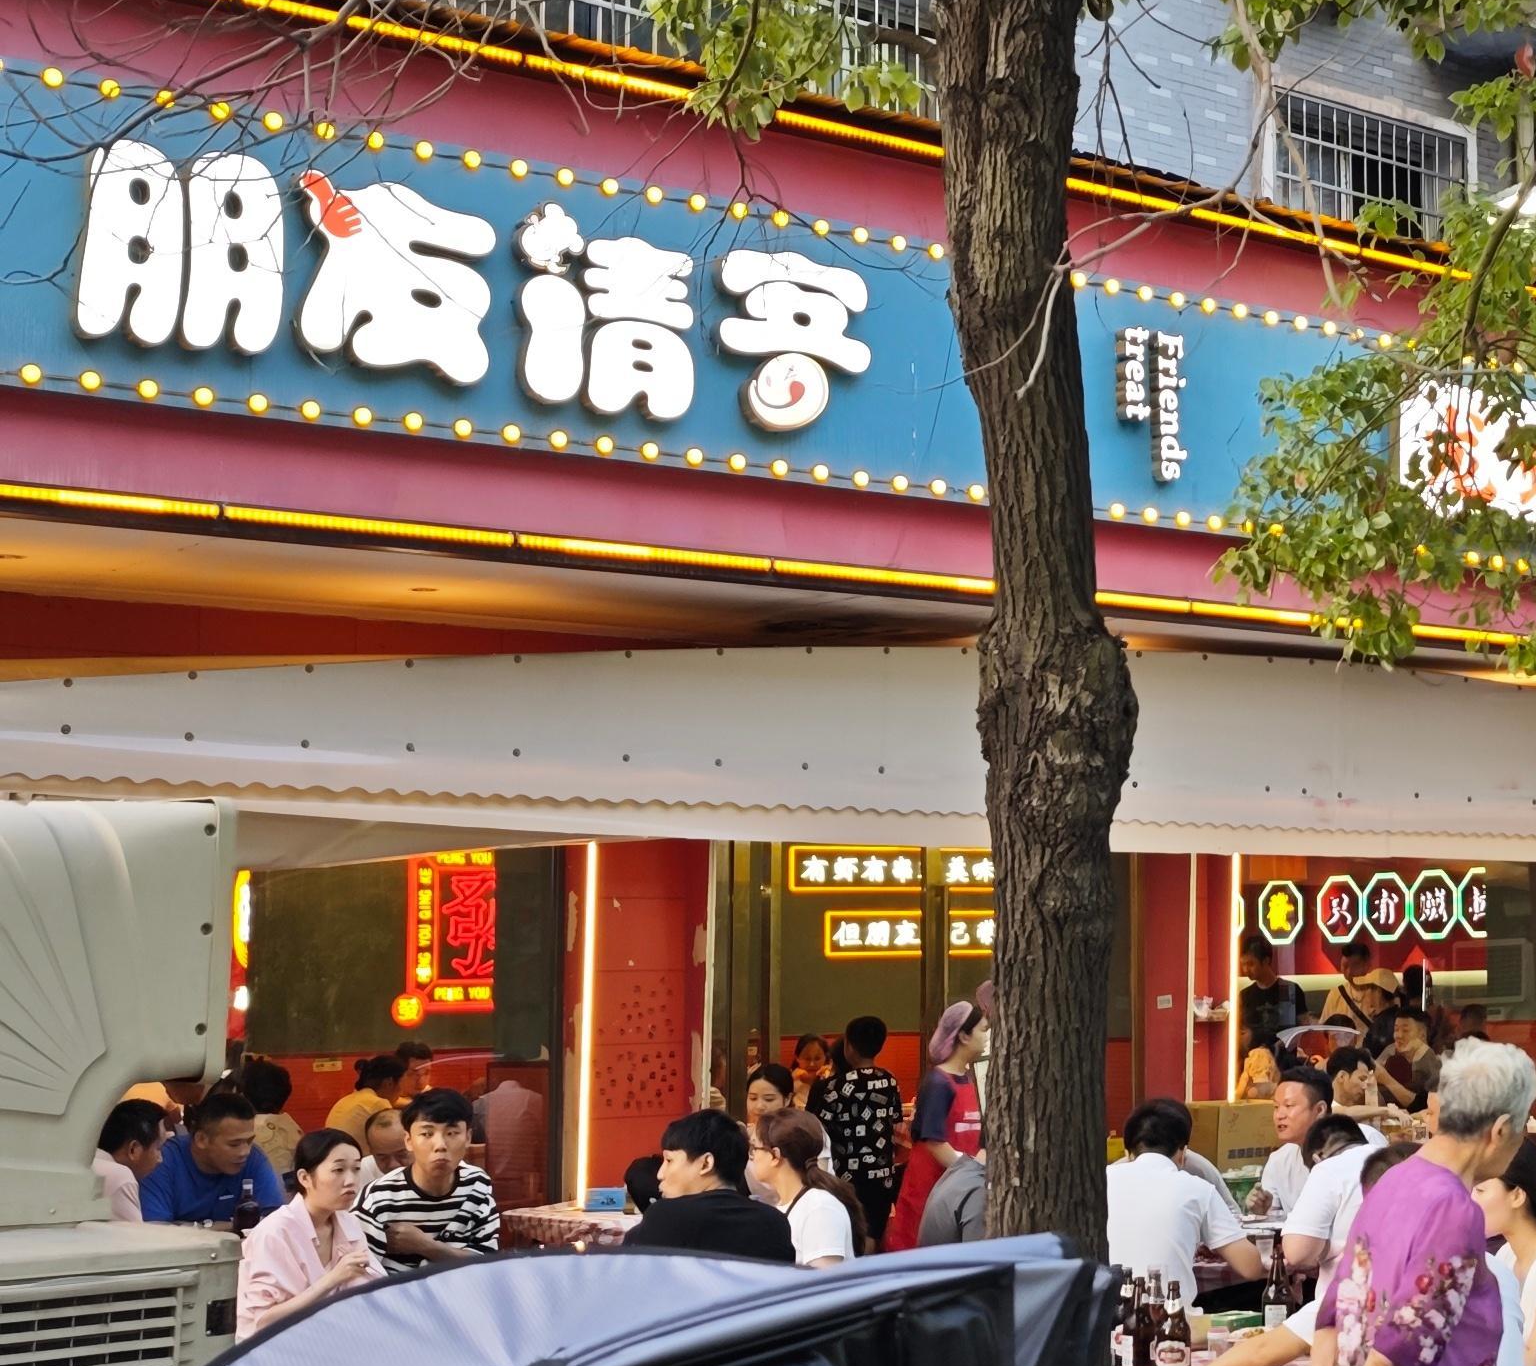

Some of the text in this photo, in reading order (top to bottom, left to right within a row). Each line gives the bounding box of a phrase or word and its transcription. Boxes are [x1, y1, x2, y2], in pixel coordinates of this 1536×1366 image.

[74, 139, 871, 431] 朋友请客
[1125, 326, 1151, 421] treat
[1157, 330, 1187, 480] Friends
